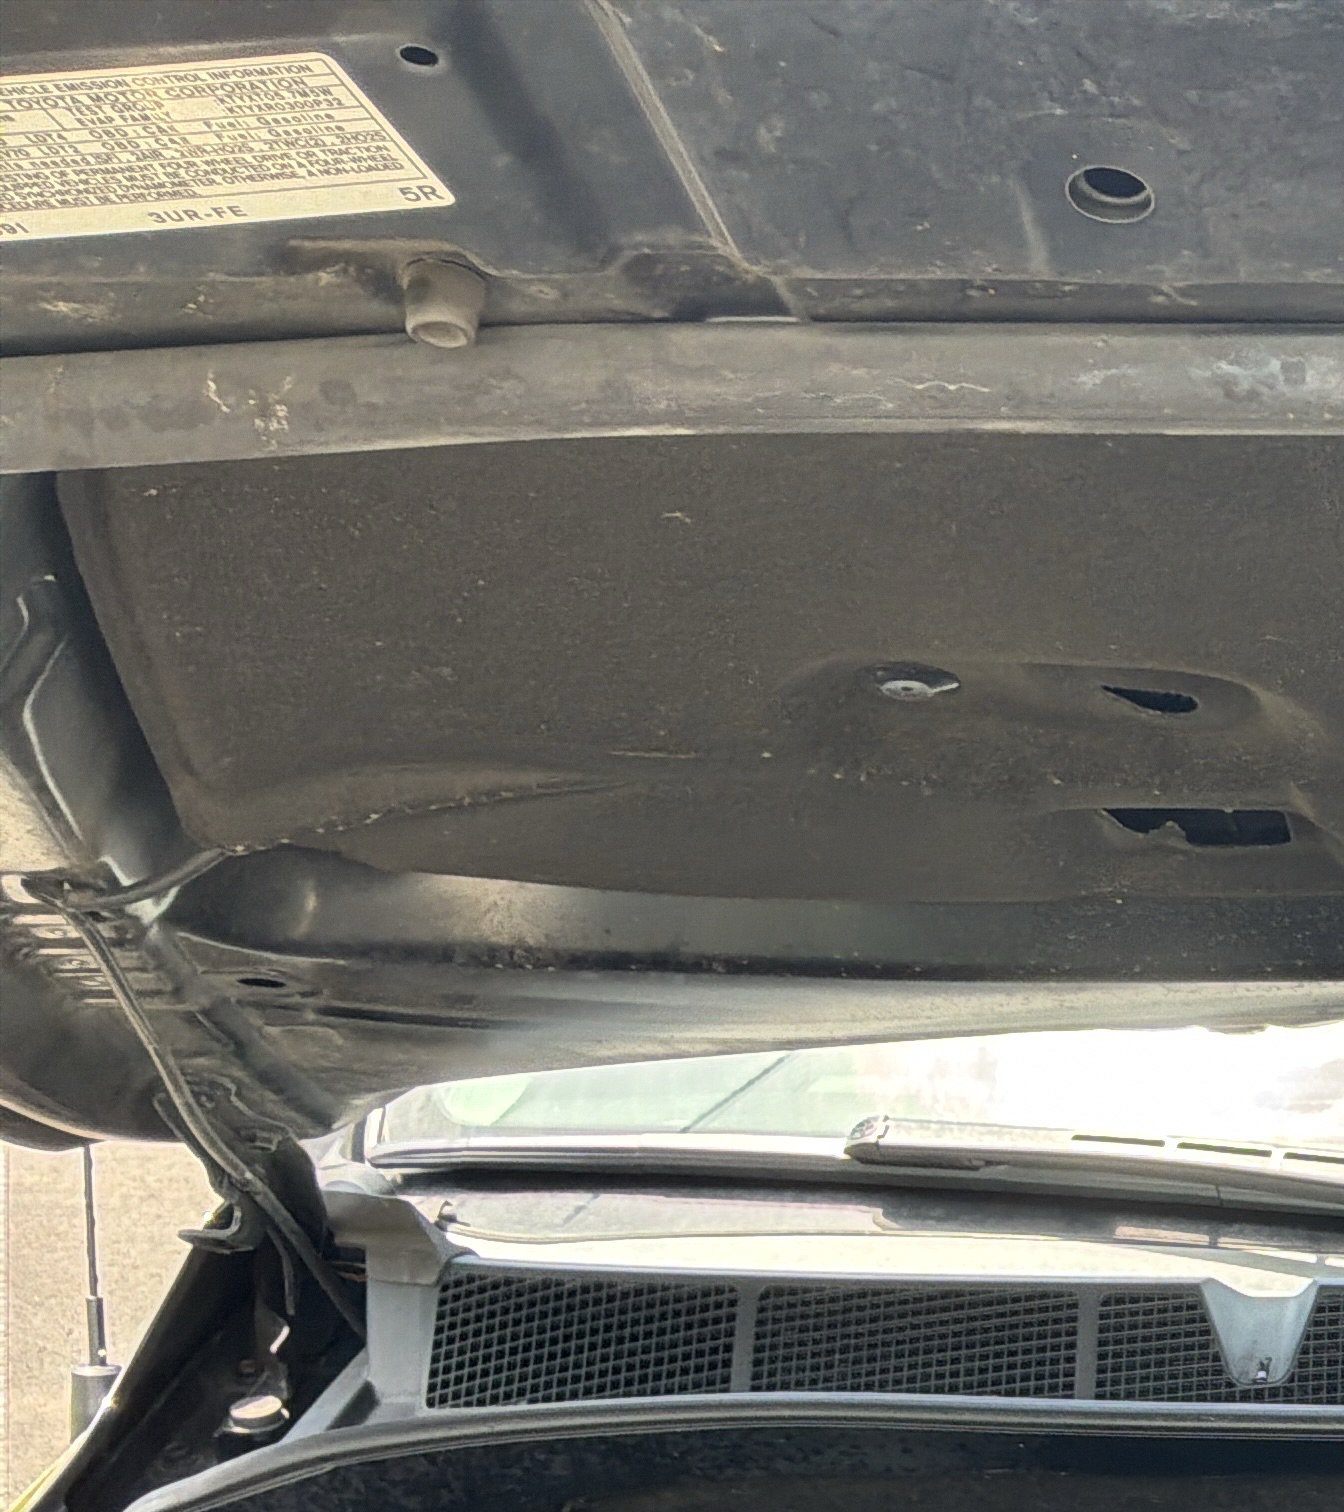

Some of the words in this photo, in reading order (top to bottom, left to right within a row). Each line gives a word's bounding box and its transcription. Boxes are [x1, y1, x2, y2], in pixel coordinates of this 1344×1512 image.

[0, 85, 52, 96] EHICLE
[53, 79, 129, 91] EMISSION
[130, 73, 206, 85] CONTROL
[207, 65, 313, 79] INFORMATION
[3, 95, 83, 109] TOYOTA
[86, 89, 160, 103] MOTOR
[162, 77, 307, 97] CORPORATION
[66, 106, 106, 116] TEST
[110, 101, 166, 112] GROUP
[76, 116, 116, 125] EVAP
[119, 112, 173, 122] FAMILY
[255, 112, 334, 125] Gasoline
[267, 124, 345, 137] Gasoline
[72, 164, 156, 176] PERMANENT
[159, 160, 198, 169] FOUR
[200, 156, 250, 166] WHEEL
[252, 153, 294, 162] DRIVE
[320, 145, 389, 156] TRACTION
[123, 173, 161, 182] MUST
[185, 164, 271, 177] CONDUCTED
[272, 162, 294, 170] ON
[308, 154, 397, 167] FOUR-WHEEL
[318, 162, 404, 175] NON-LOADED
[147, 205, 247, 223] 3UR-FE
[397, 185, 442, 201] 5R
